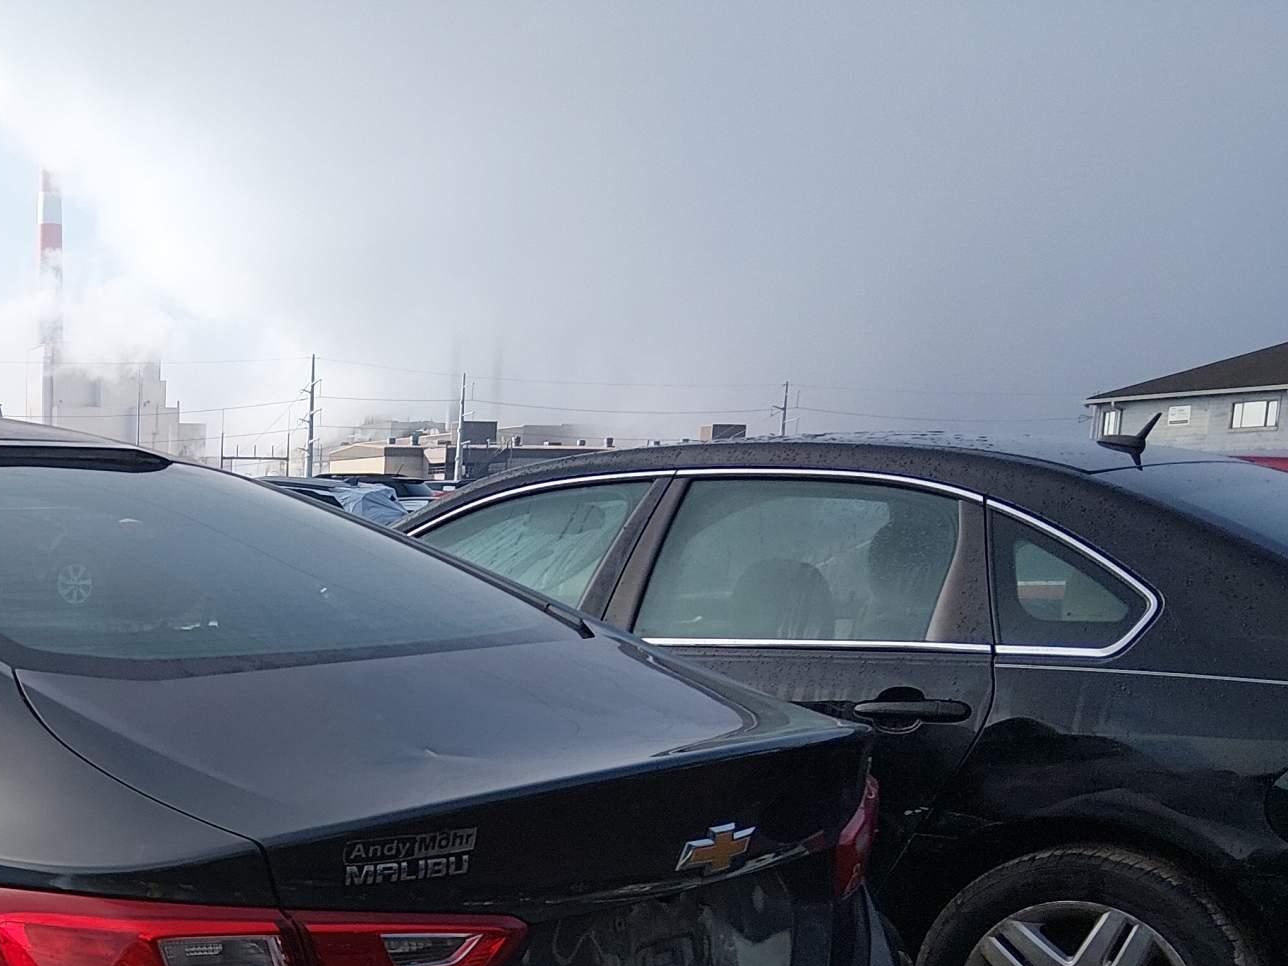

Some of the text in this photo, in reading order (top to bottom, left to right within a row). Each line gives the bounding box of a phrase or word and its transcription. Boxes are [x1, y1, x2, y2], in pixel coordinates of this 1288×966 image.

[350, 832, 474, 859] Andy Mohr
[345, 854, 470, 886] MALIBU
